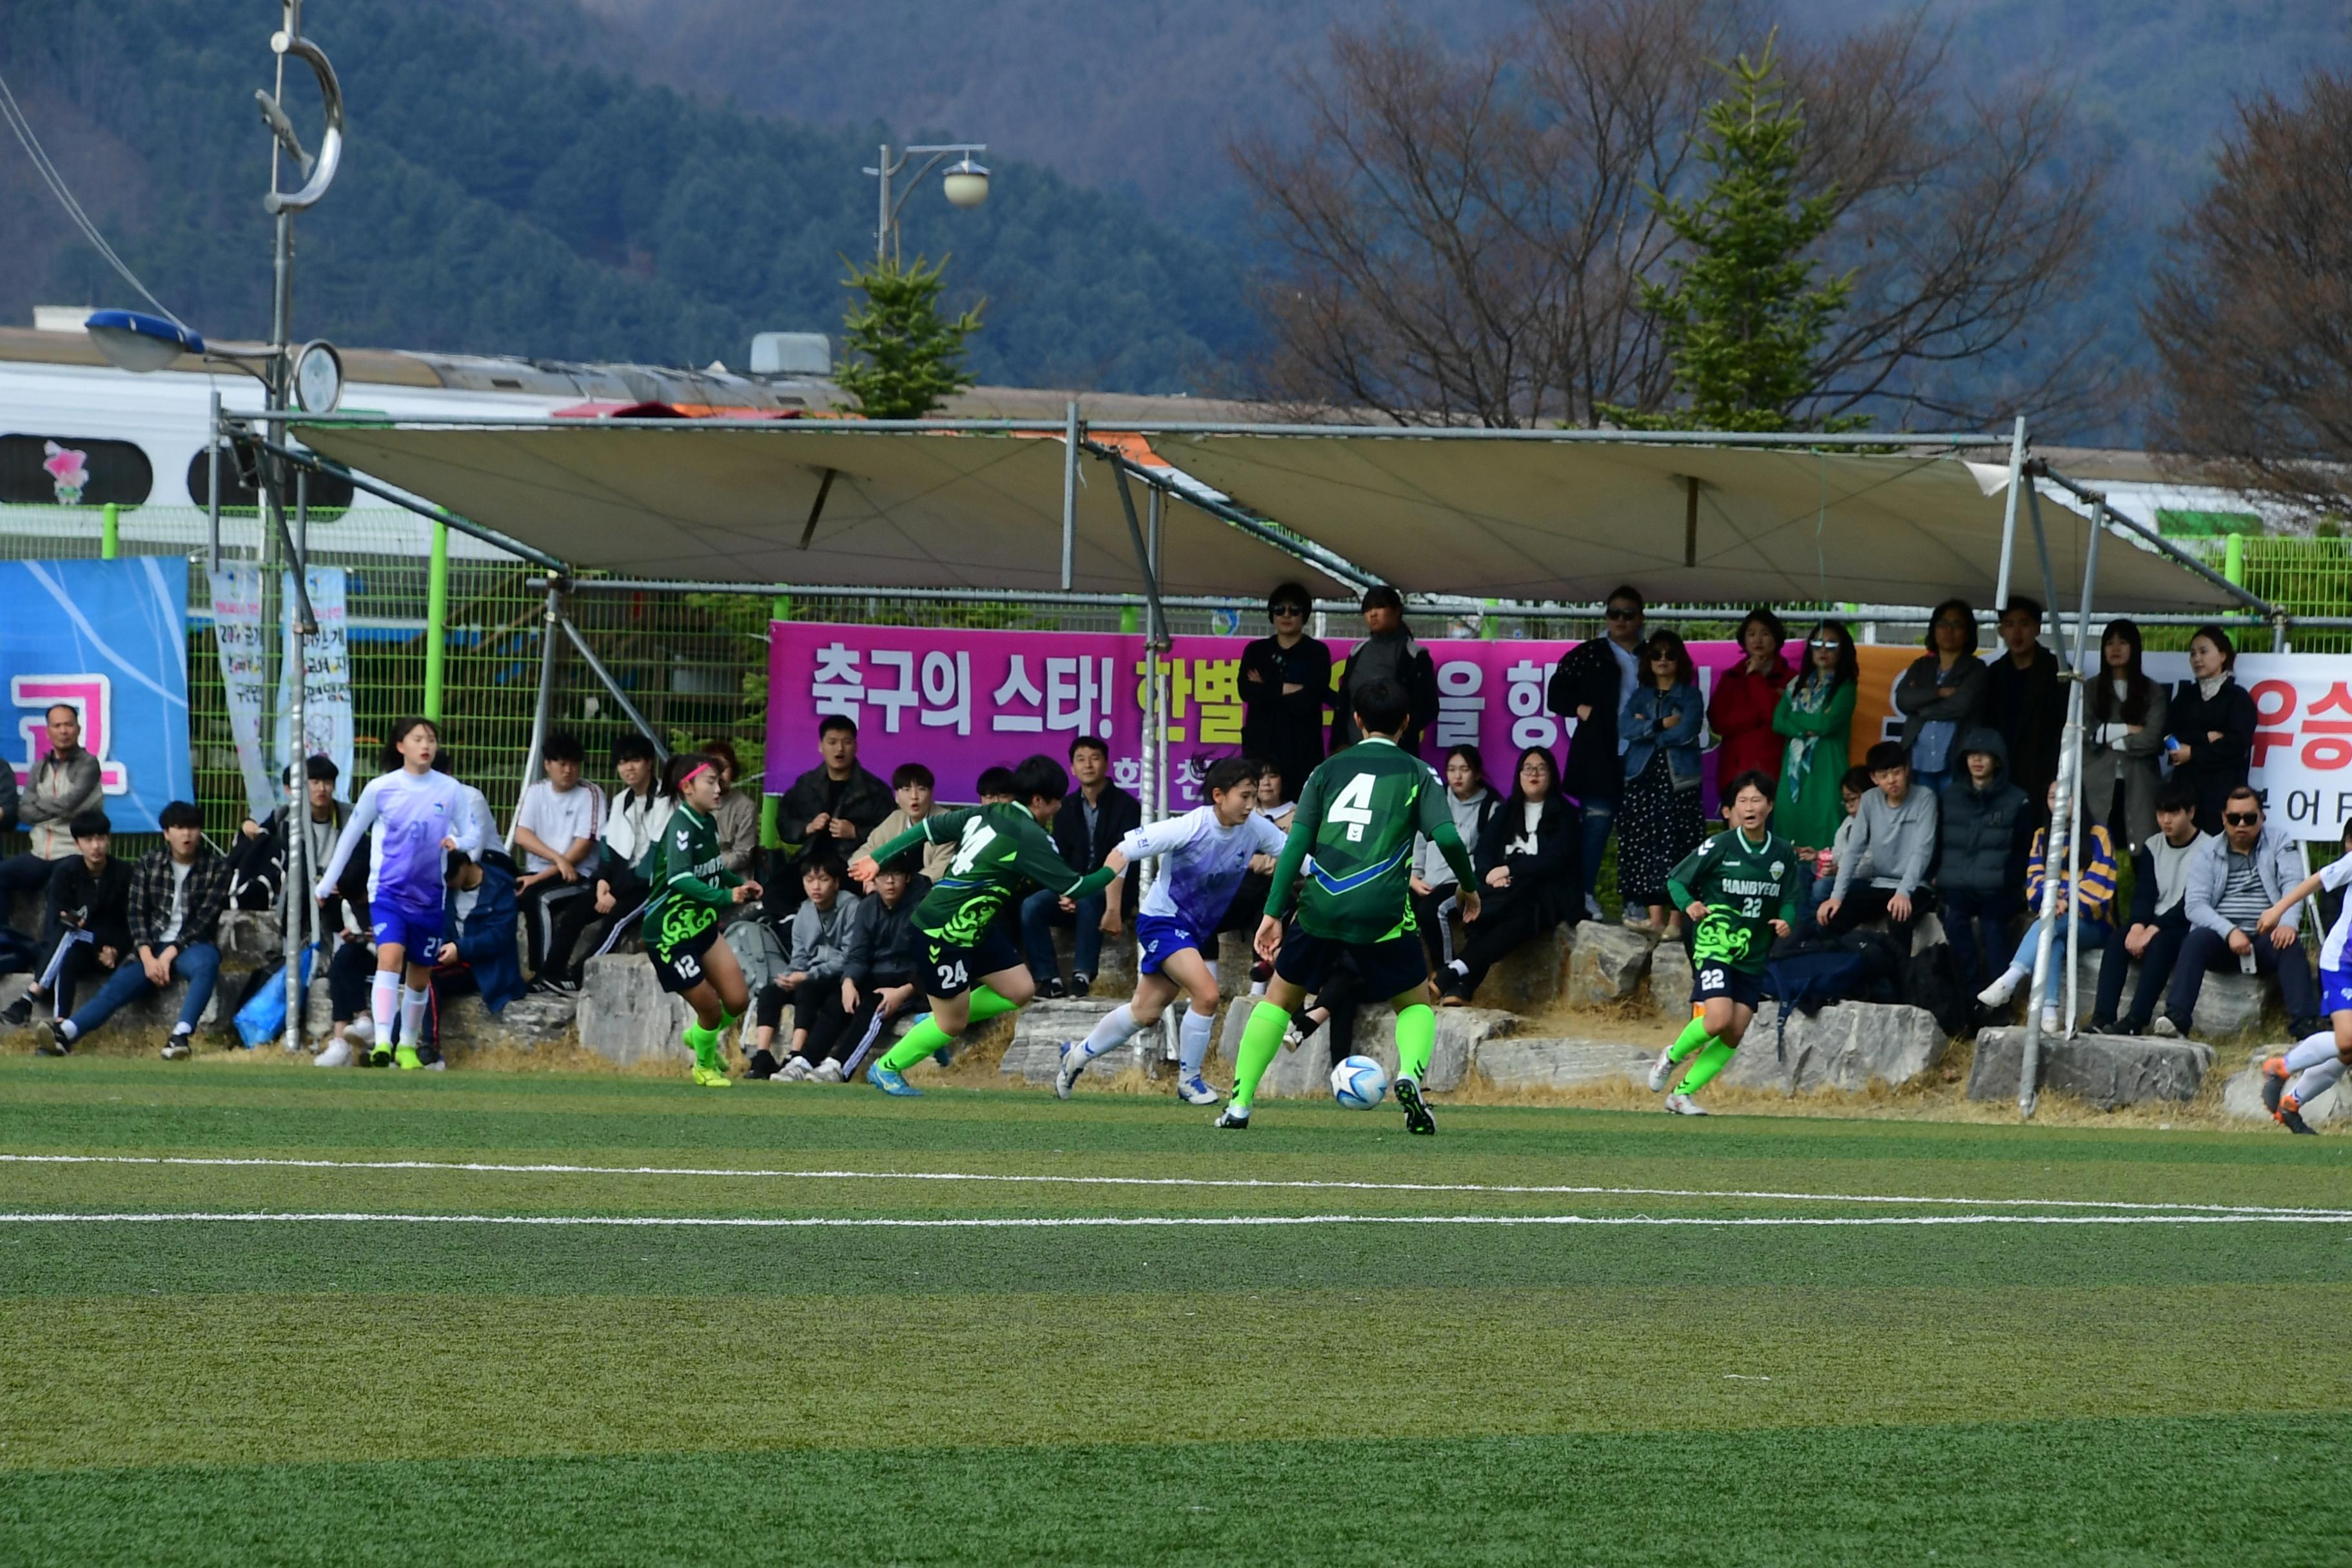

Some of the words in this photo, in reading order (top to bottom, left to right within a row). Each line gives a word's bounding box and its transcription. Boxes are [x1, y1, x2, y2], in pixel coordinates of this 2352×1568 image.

[812, 642, 971, 736] 축구의
[993, 654, 1113, 739] 스타!
[2248, 679, 2352, 770] 우승
[1328, 773, 1376, 841] 4
[409, 820, 429, 839] 21
[1741, 897, 1762, 918] 22
[423, 937, 443, 957] 21
[674, 954, 701, 980] 12
[937, 959, 968, 990] 24
[1700, 968, 1725, 991] 22
